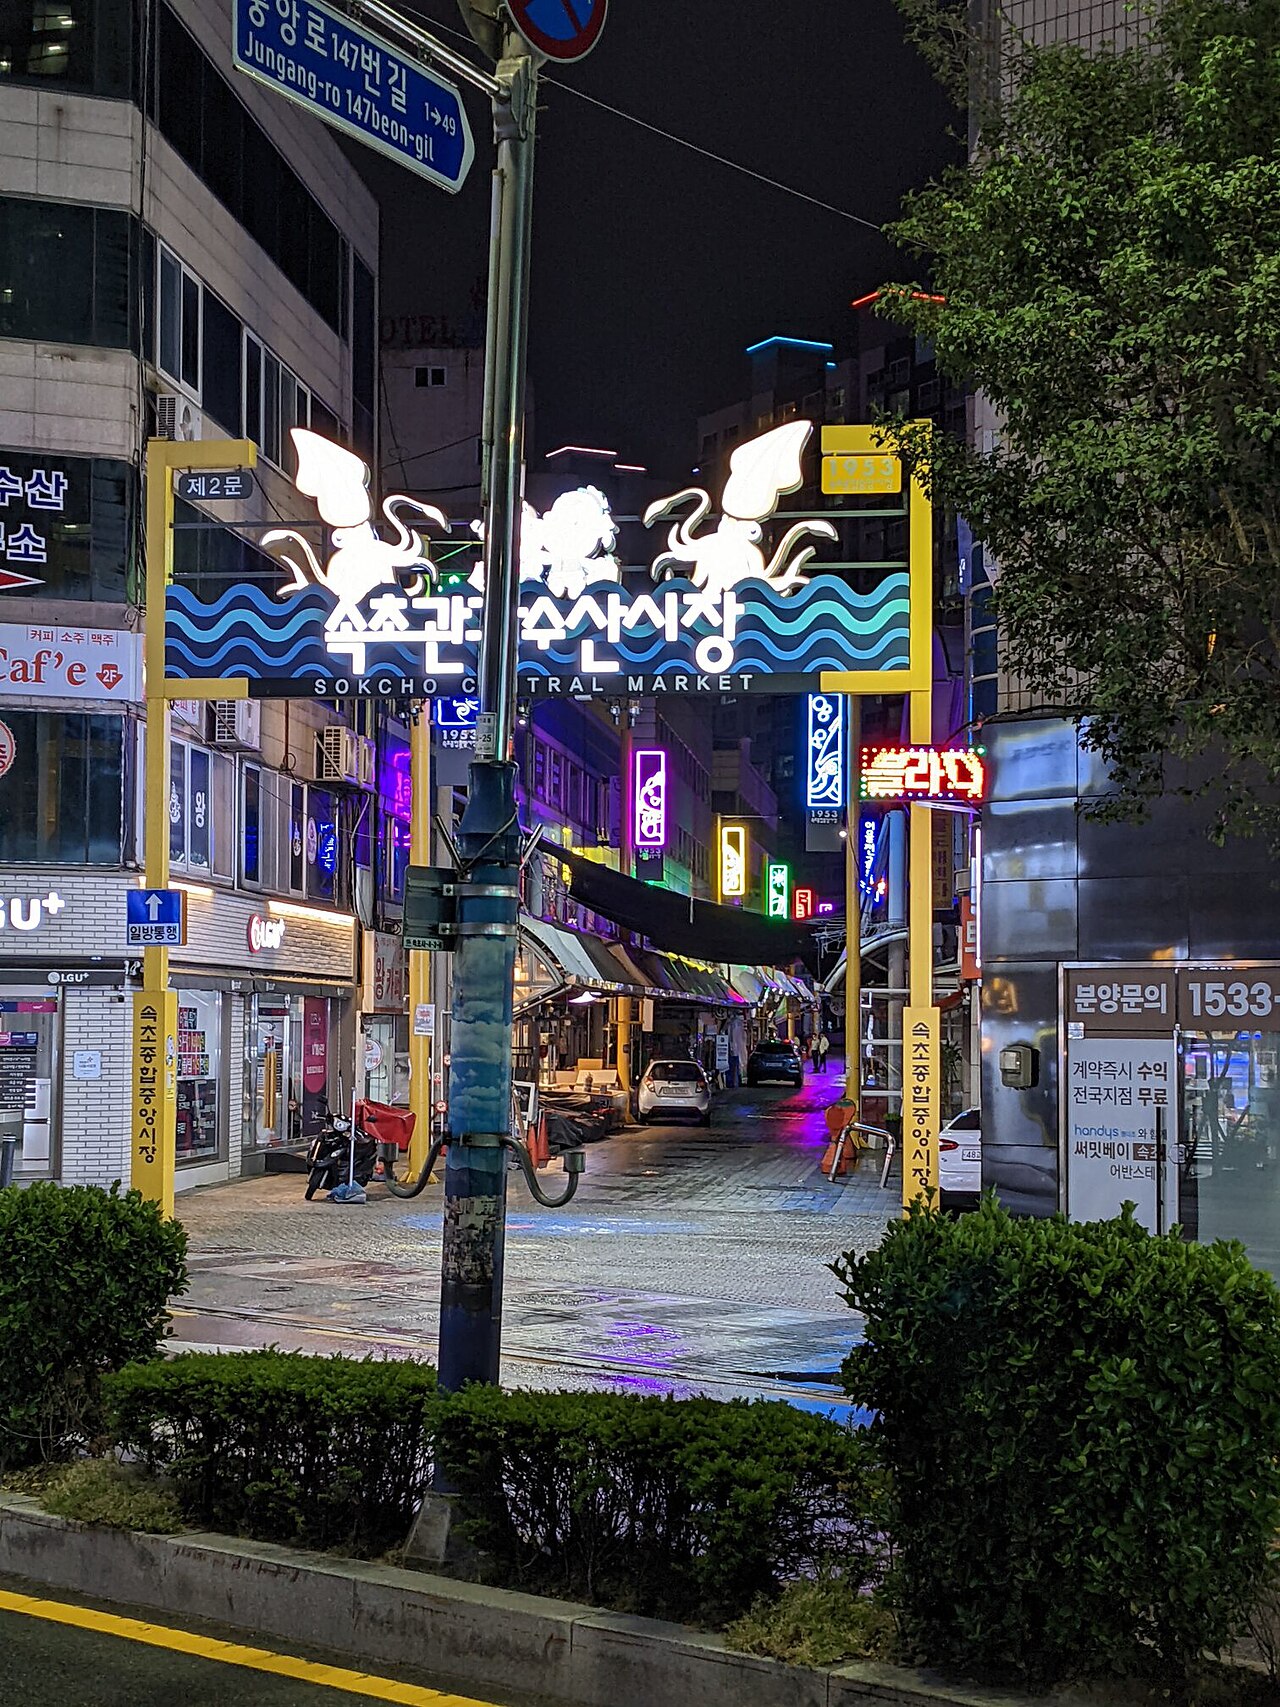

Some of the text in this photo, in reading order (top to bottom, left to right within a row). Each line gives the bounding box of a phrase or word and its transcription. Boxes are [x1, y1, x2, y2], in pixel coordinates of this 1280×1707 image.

[245, 31, 434, 161] Jungang-ro 147beon-gil
[442, 116, 457, 137] 49
[829, 458, 895, 477] 1953
[187, 476, 243, 497] 제2문
[0, 521, 47, 563] 소
[30, 629, 115, 646] 커피 소주 맥주
[102, 669, 117, 684] 2F
[313, 675, 754, 694] SOKCHO CTRAL MARKET
[441, 729, 476, 741] 1953
[811, 811, 839, 819] 1953
[0, 892, 66, 930] U+
[129, 926, 178, 941] 일방통행
[61, 971, 90, 983] LGU+
[1074, 983, 1167, 1014] 분양문의
[1073, 1061, 1167, 1081] 계약즉시 수익
[138, 1005, 158, 1164] 속초종합중앙시장
[911, 1021, 931, 1188] 속초종합중앙시장
[1073, 1086, 1168, 1106] 전국지점 무료
[1074, 1125, 1119, 1140] handys
[1074, 1141, 1129, 1160] 써밋베이
